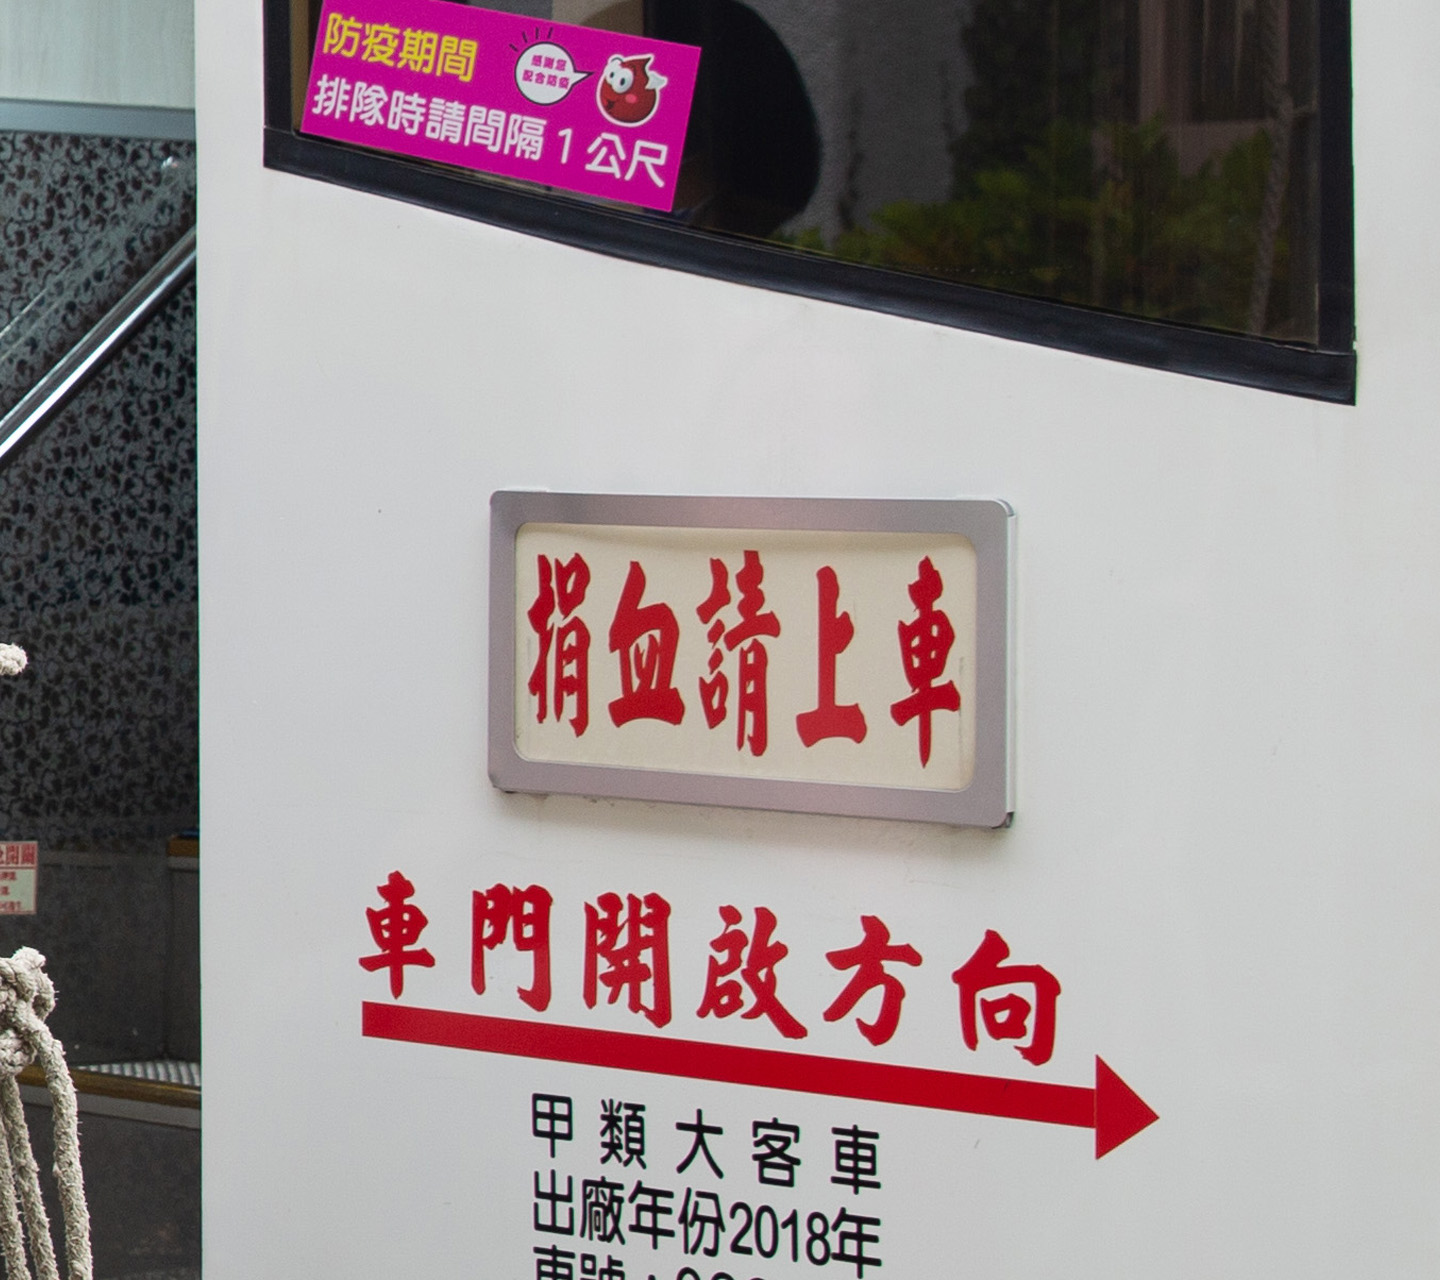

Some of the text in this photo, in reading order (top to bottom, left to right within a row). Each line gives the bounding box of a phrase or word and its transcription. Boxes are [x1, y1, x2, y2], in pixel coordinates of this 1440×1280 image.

[322, 12, 478, 82] 防疫期間
[521, 69, 570, 90] 配合防疫
[530, 54, 567, 72] 感謝您
[311, 74, 669, 189] 排隊時請間隔 1 公尺
[525, 548, 963, 770] 捐血請上車
[358, 870, 1062, 1066] 車門開啟方向
[532, 1169, 883, 1279] 出廠年份2018年
